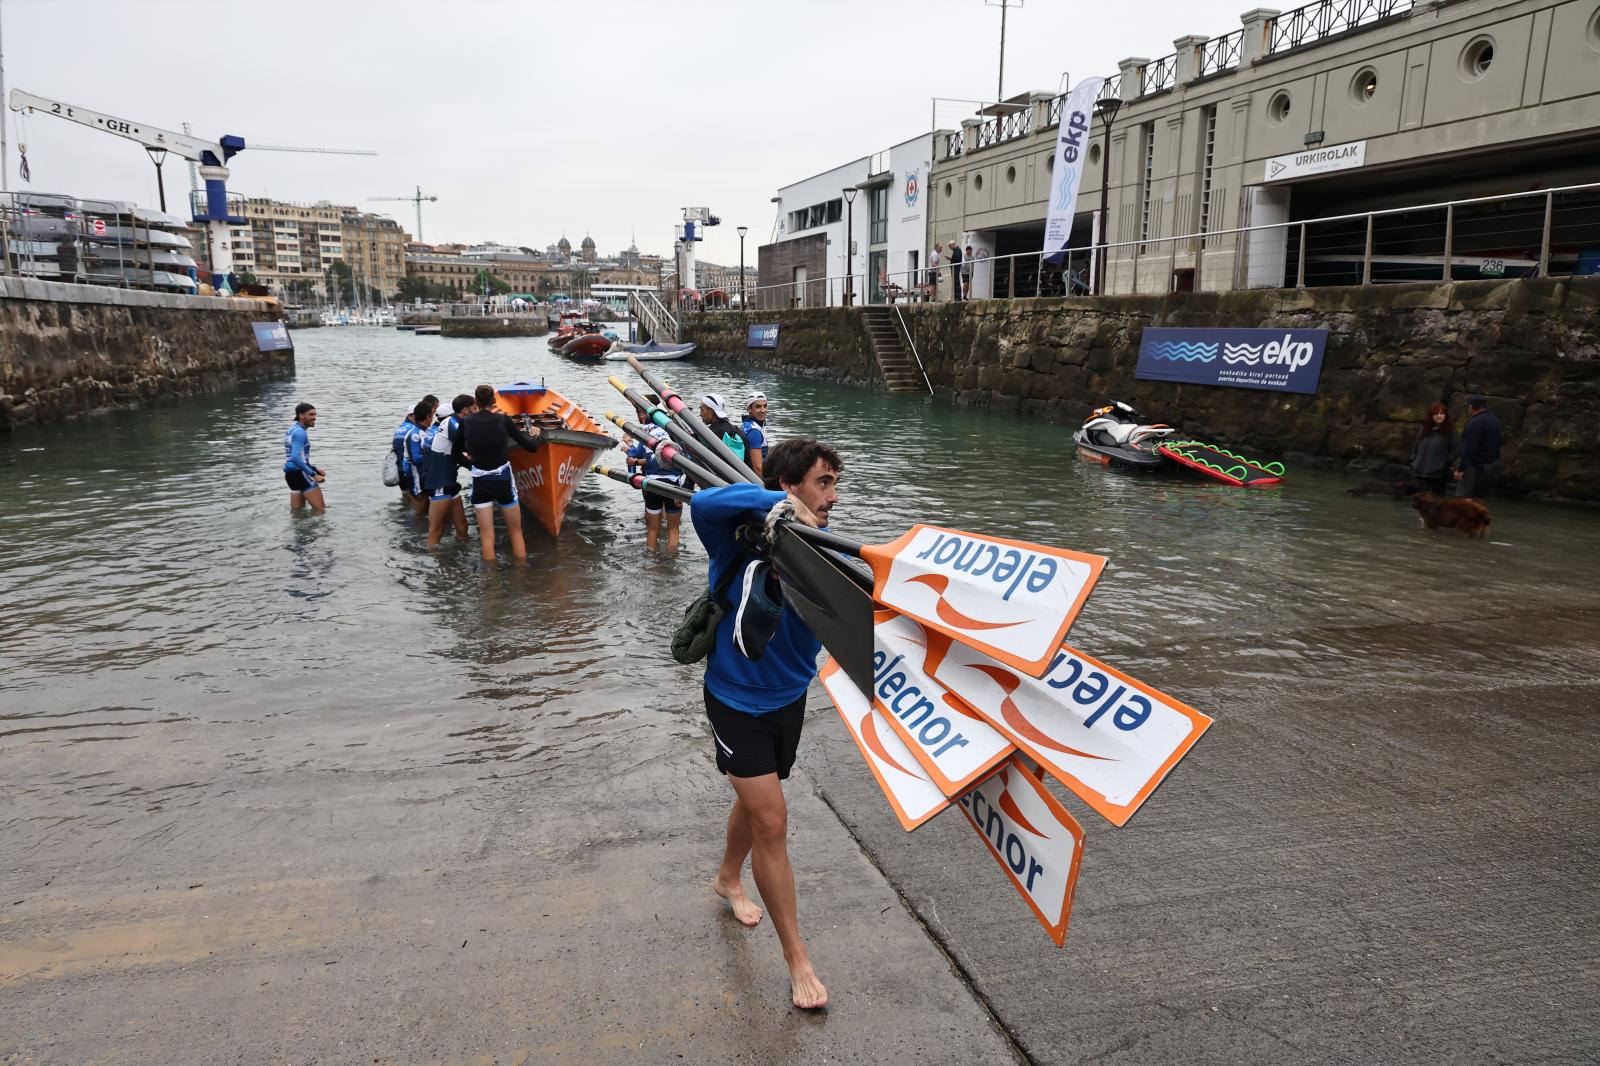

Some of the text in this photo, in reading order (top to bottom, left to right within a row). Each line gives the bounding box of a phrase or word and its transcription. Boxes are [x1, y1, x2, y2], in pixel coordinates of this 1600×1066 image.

[51, 103, 74, 117] 2 t
[1061, 111, 1088, 163] ekp
[1296, 145, 1358, 166] URKIROLAK
[1482, 259, 1504, 271] 236
[1262, 333, 1314, 373] ekp
[916, 534, 1058, 601] elecnor
